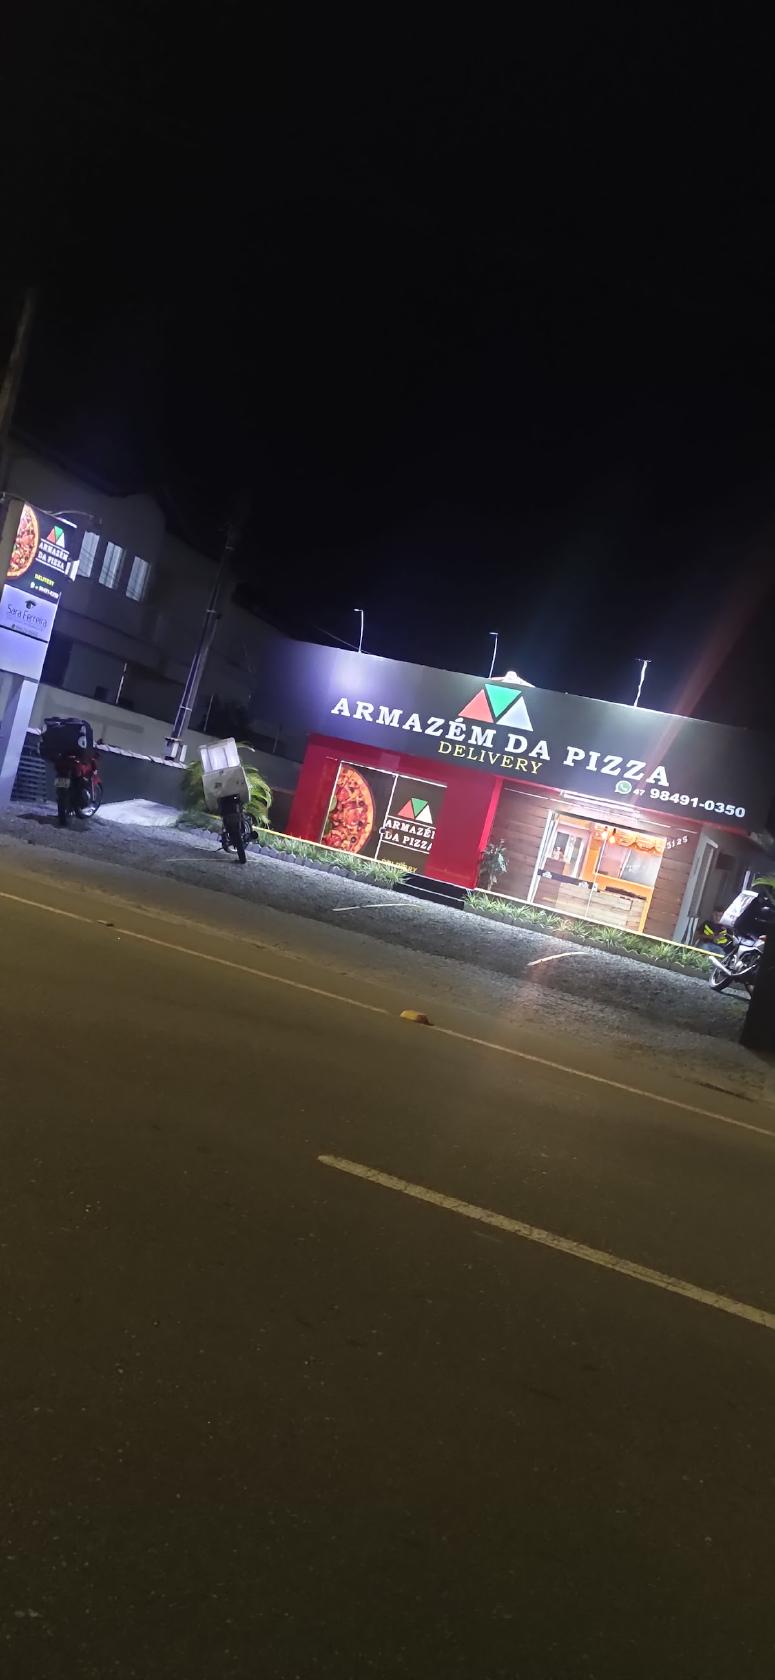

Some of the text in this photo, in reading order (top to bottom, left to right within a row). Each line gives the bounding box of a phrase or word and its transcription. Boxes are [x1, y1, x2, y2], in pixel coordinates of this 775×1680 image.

[331, 697, 670, 787] ARMAZÉM DA PIZZA
[438, 740, 543, 775] DELIVERY
[633, 788, 746, 818] 47 98491-0350
[384, 830, 400, 842] DA
